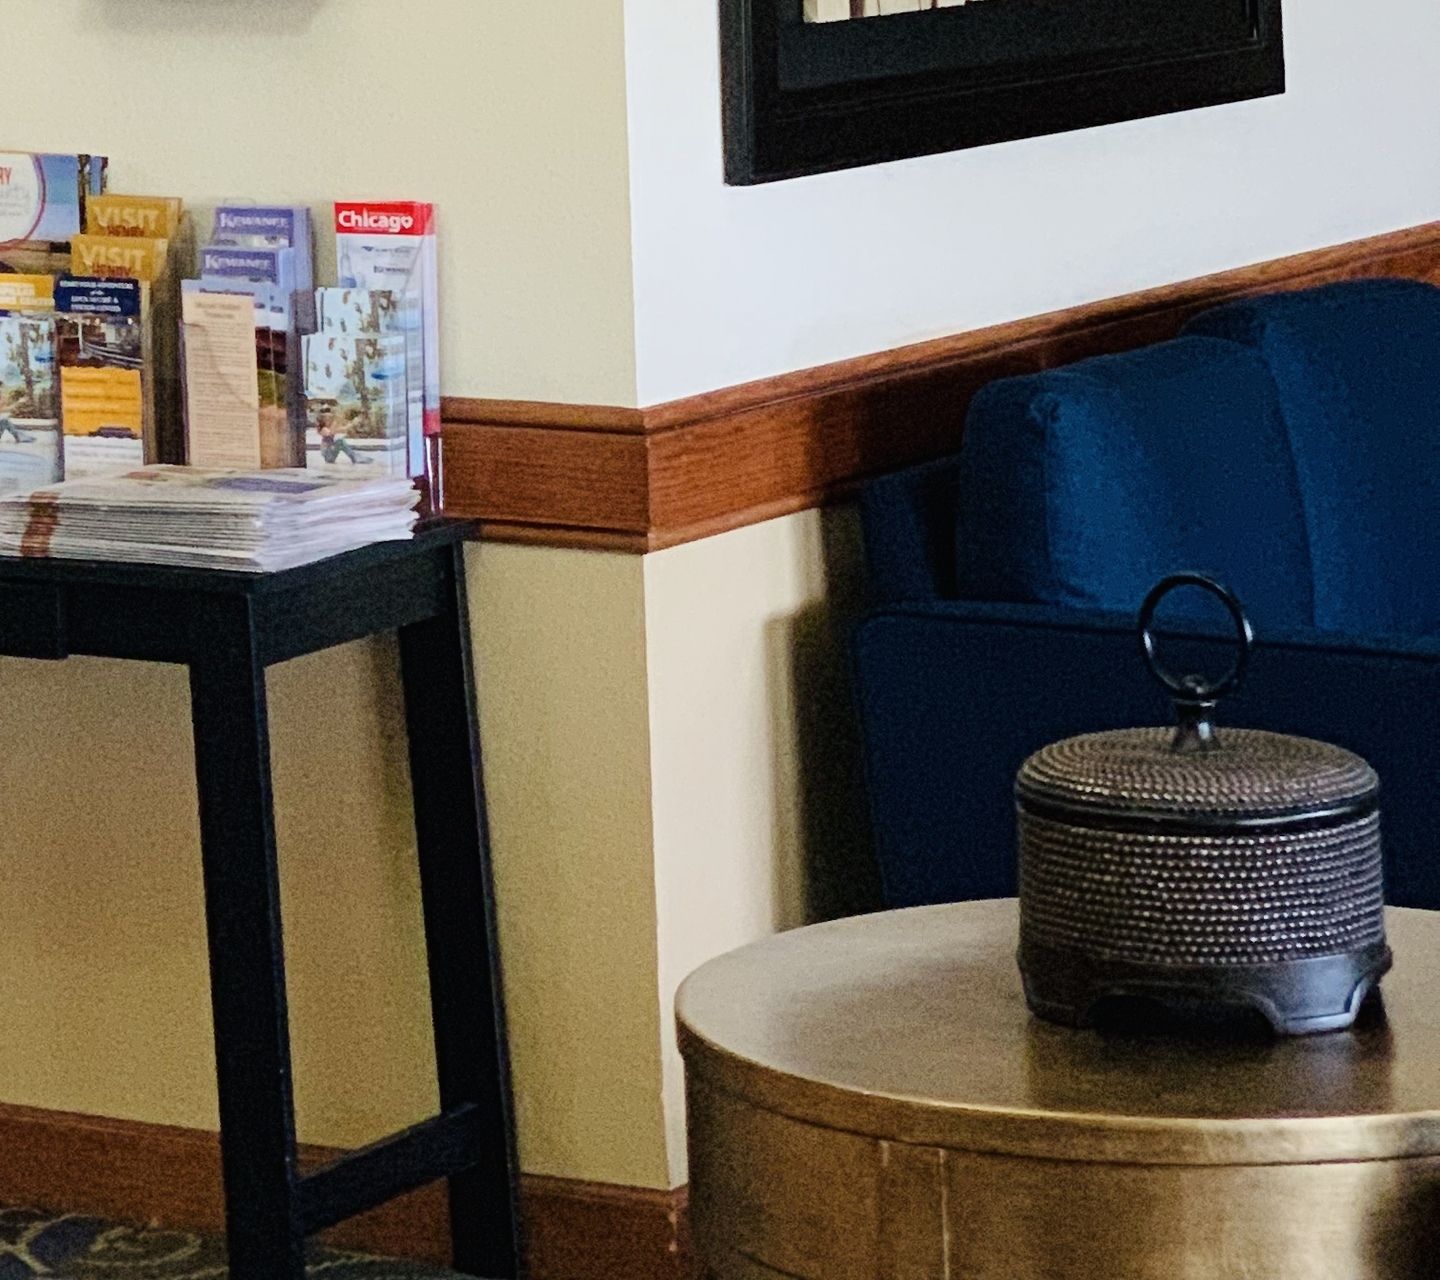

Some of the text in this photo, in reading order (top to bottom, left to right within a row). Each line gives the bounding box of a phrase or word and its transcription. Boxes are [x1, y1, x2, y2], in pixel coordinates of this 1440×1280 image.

[93, 206, 160, 230] VISIT
[338, 207, 414, 233] Chicago
[78, 243, 147, 271] VISIT
